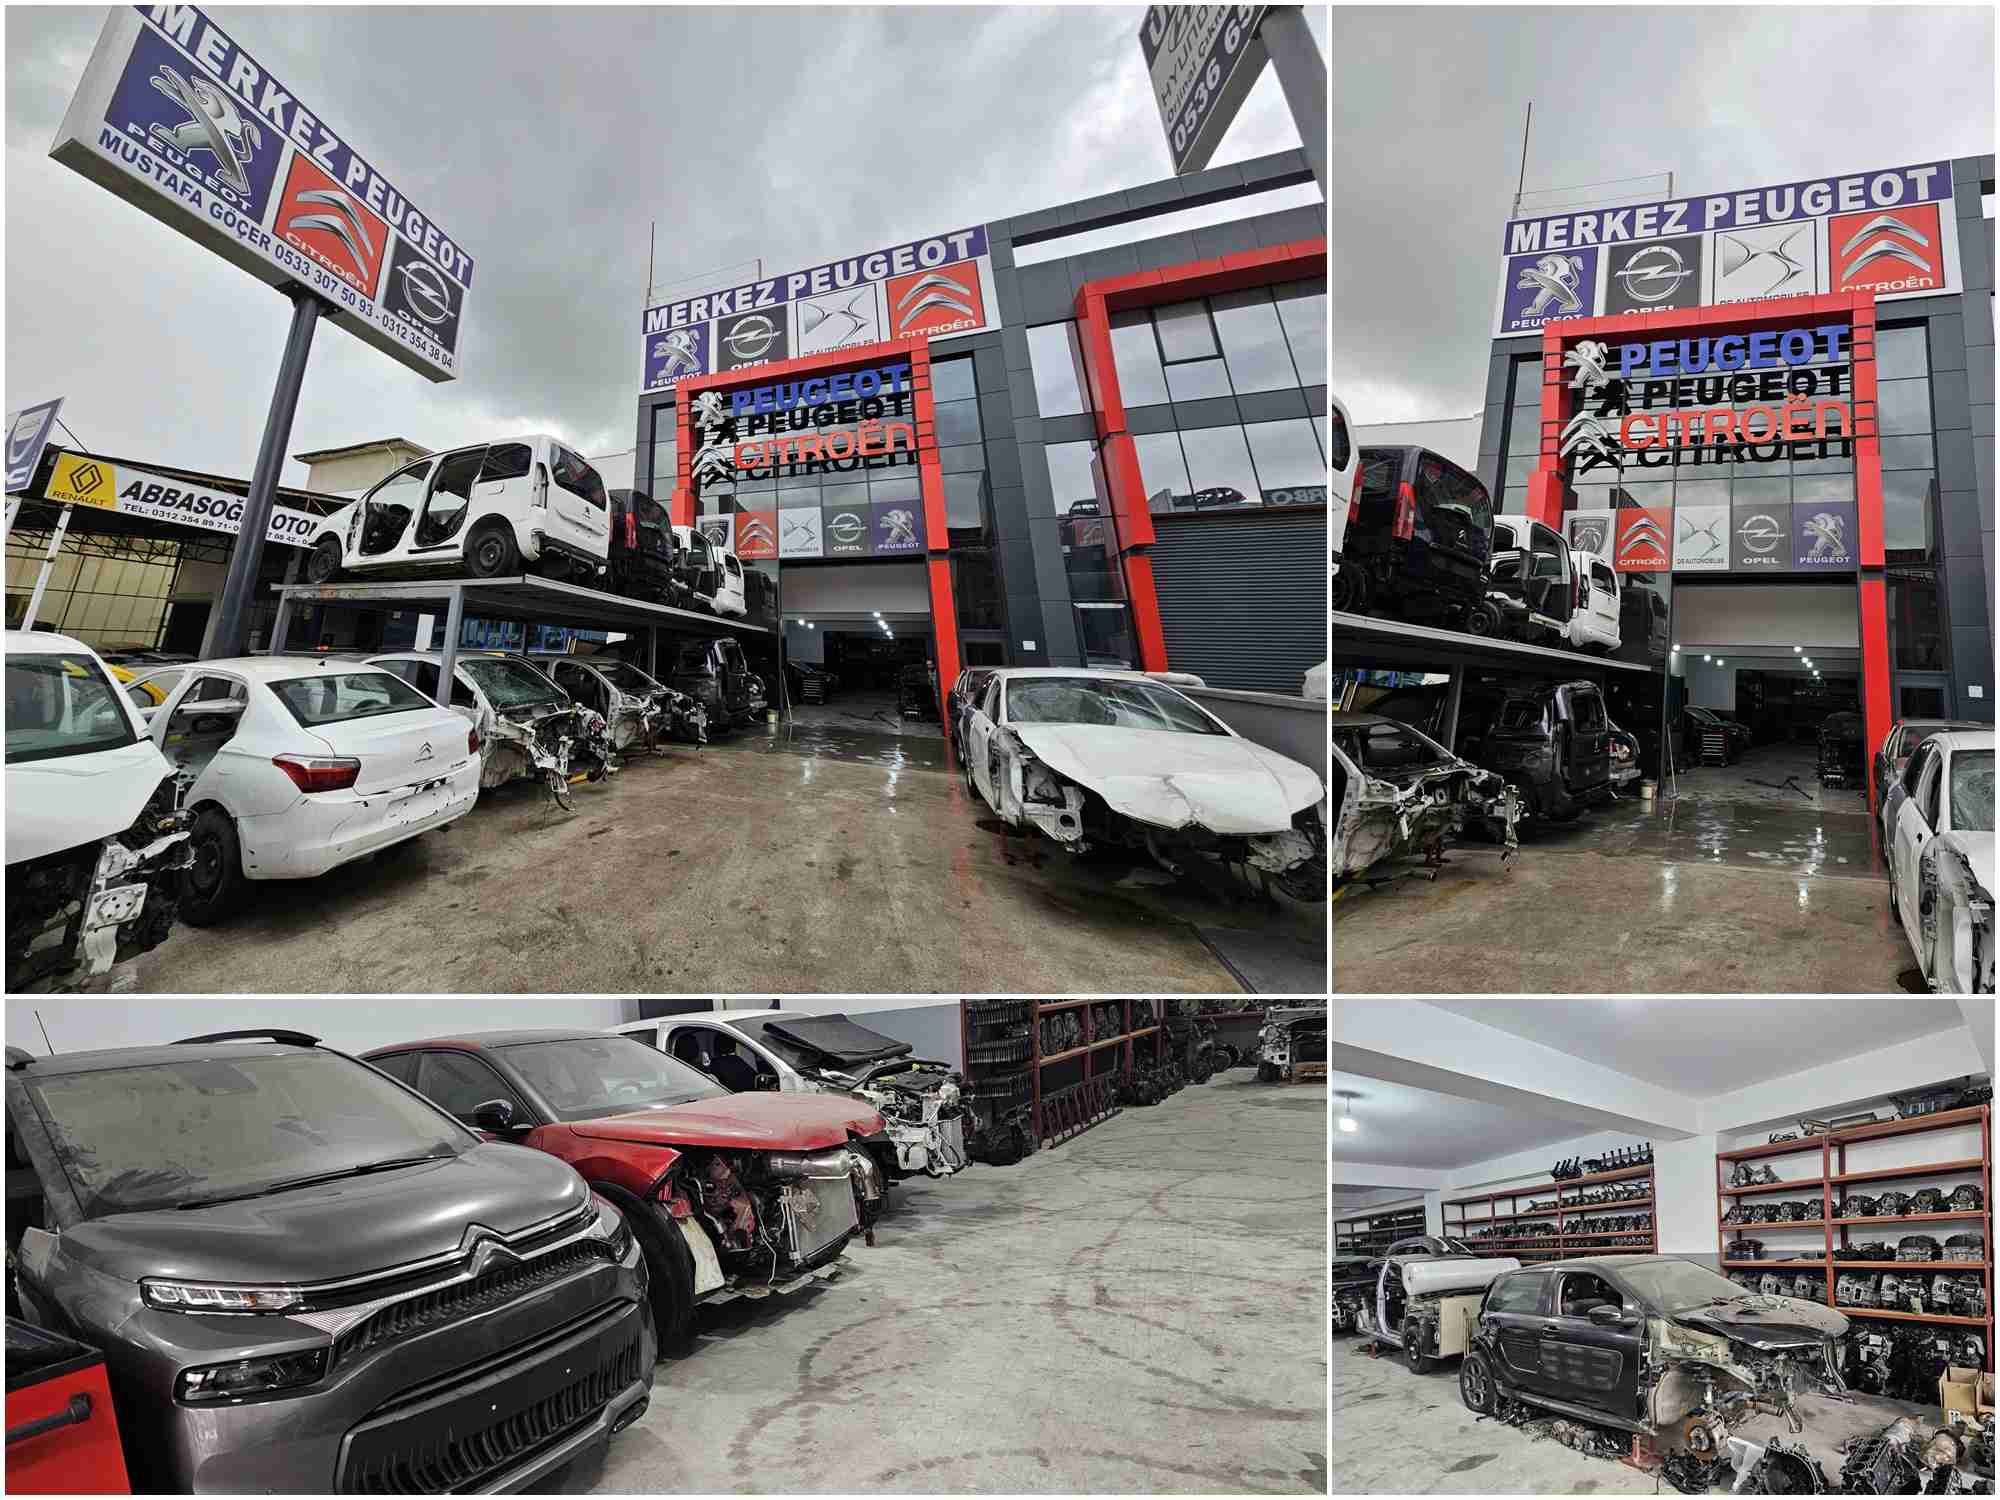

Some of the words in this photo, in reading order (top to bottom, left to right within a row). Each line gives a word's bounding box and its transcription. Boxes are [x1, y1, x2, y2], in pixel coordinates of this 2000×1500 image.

[1175, 57, 1221, 152] 0536
[127, 122, 254, 210] PEUGEOT
[150, 5, 338, 170] MERKEZ
[345, 155, 469, 281] PEUGEOT
[1510, 203, 1689, 253] MERKEZ
[1704, 166, 1938, 229] PEUGEOT
[99, 128, 202, 208] MUSTAFA
[209, 201, 271, 251] GÖÇER
[275, 244, 310, 277] 0533
[314, 271, 338, 293] 307
[341, 288, 356, 307] 50
[359, 302, 373, 317] 93
[382, 314, 408, 340] 0312
[410, 334, 427, 352] 354
[441, 354, 452, 368] 04
[646, 281, 776, 333] MERKEZ
[788, 230, 975, 299] PEUGEOT
[397, 309, 445, 346] OPEL
[1620, 324, 1850, 378] PEUGEOT
[733, 363, 910, 416] PEUGEOT
[53, 490, 105, 506] RENAULT
[120, 481, 244, 522] ABBASOĞ
[124, 503, 148, 514] TEL:
[152, 508, 178, 520] 0312
[1799, 556, 1850, 565] PEUGEOT
